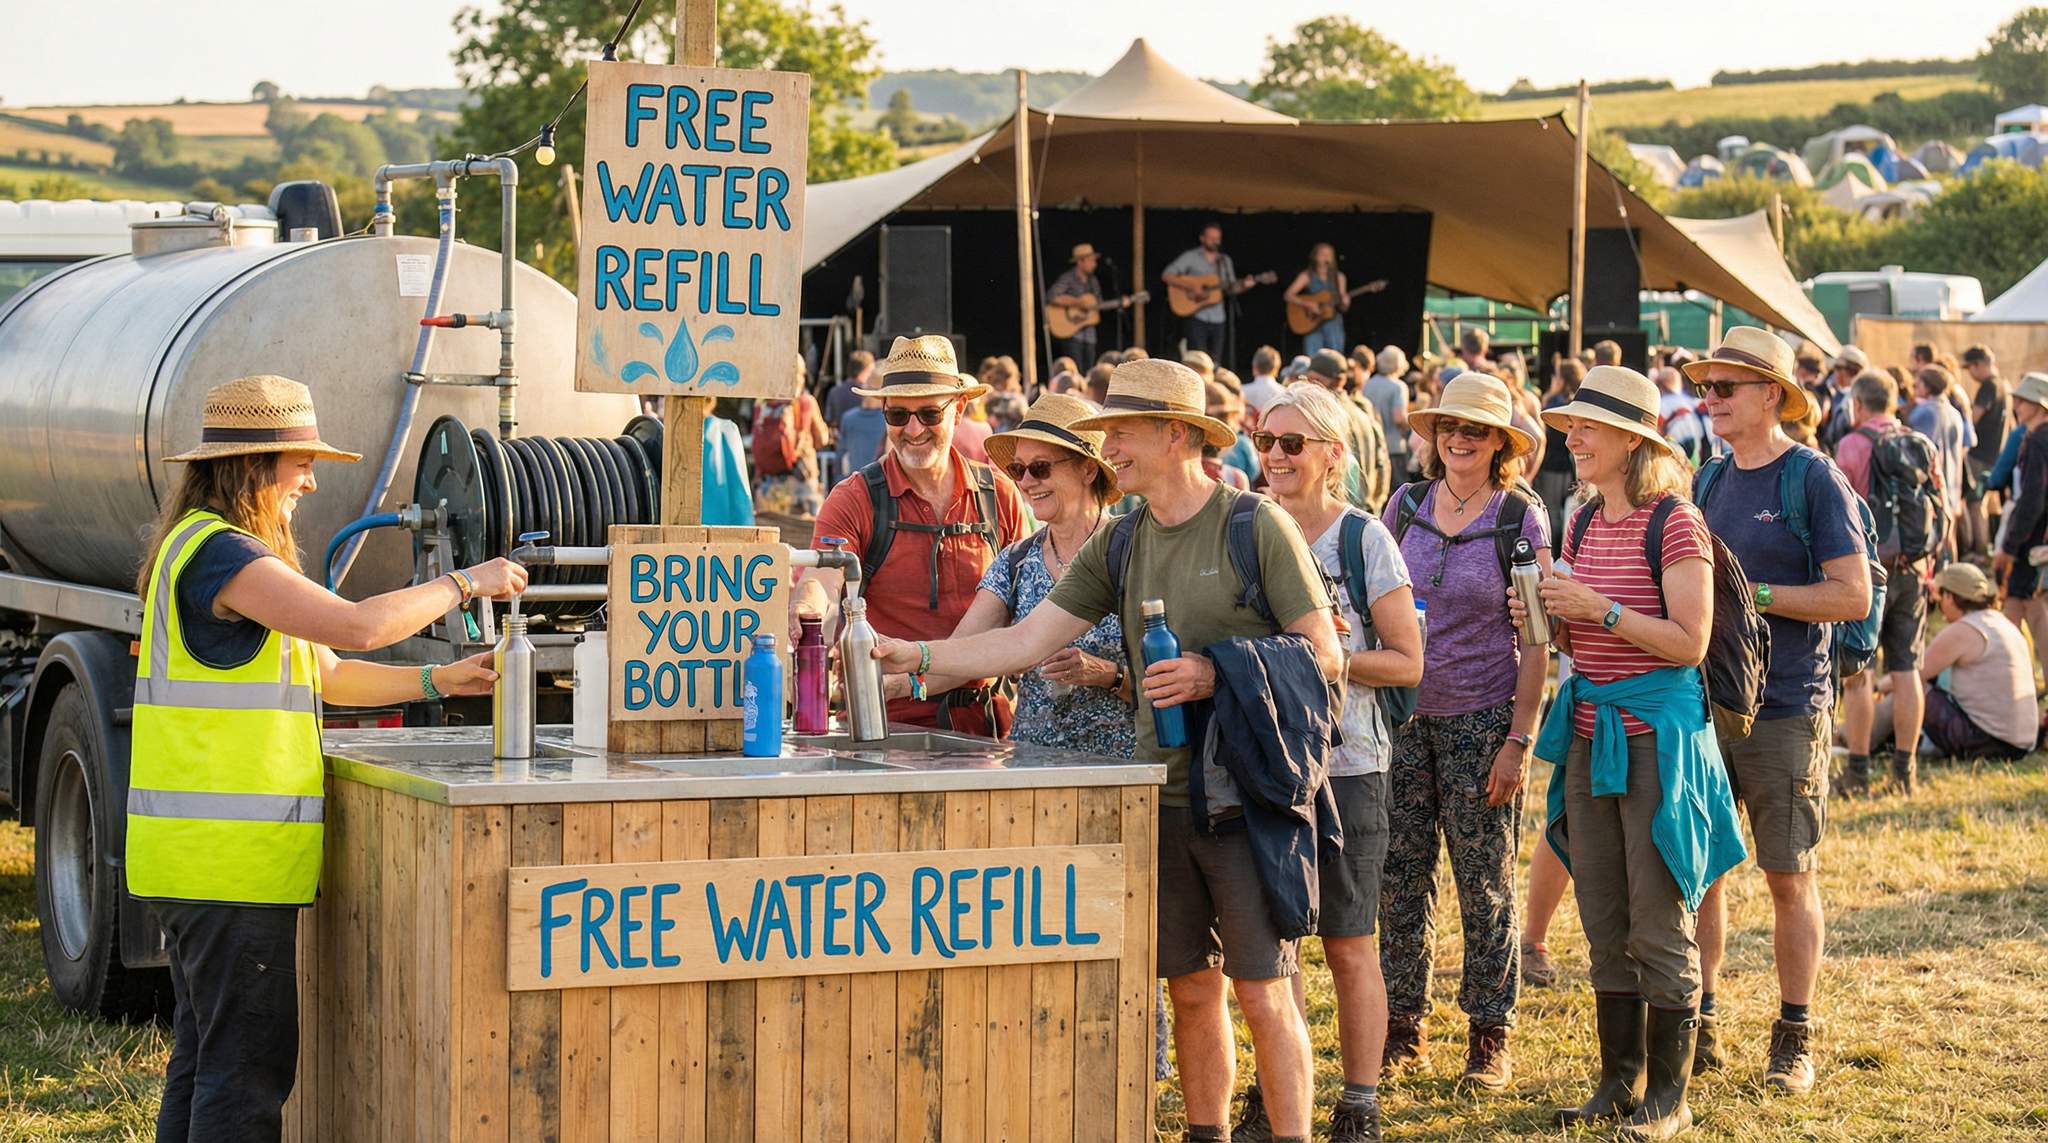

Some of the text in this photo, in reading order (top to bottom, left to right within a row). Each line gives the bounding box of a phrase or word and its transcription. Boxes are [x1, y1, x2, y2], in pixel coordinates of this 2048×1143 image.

[625, 83, 774, 154] FREE
[597, 160, 792, 232] WATER
[594, 245, 781, 317] REFILL
[630, 554, 778, 603] BRING
[638, 608, 760, 655] YOUR
[624, 659, 744, 711] BOTTL
[540, 863, 1101, 978] FREE WATER REFILL
